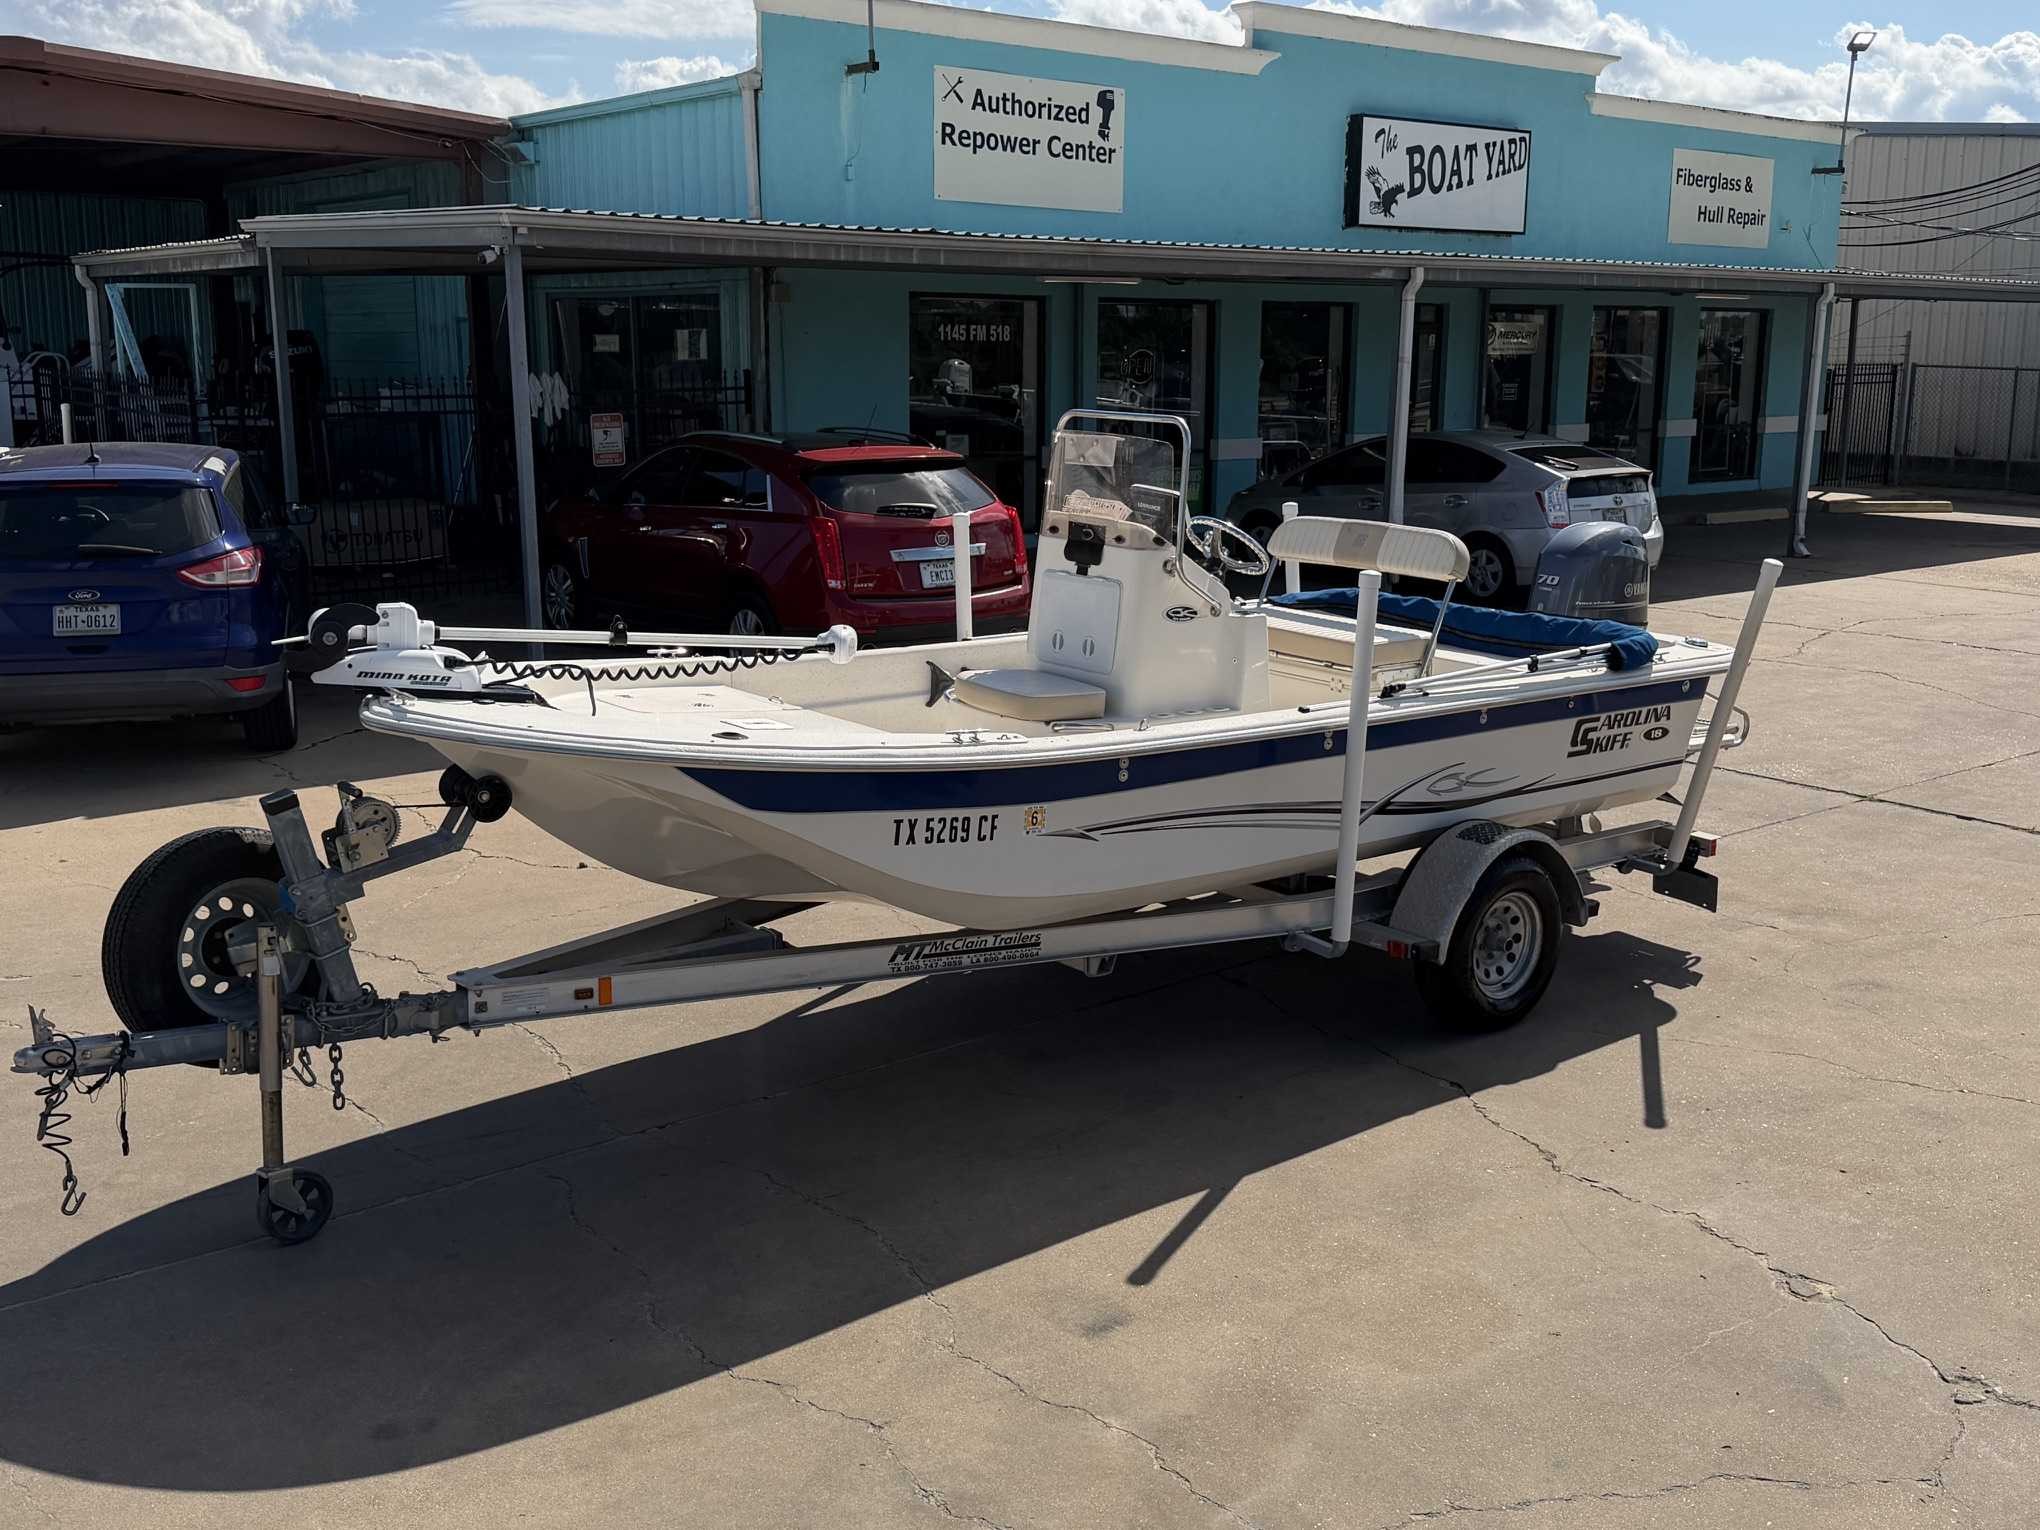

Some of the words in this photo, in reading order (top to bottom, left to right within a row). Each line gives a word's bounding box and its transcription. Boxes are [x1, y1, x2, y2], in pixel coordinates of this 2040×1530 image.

[971, 88, 1090, 125] Authorized
[940, 121, 1041, 155] Repower
[1047, 135, 1117, 164] Center
[1374, 124, 1399, 158] The
[1405, 141, 1478, 199] BOAT
[1484, 135, 1528, 181] YARD
[1676, 166, 1742, 194] Fiberglass
[1743, 176, 1754, 194] &
[1696, 206, 1725, 225] Hull
[1727, 208, 1766, 230] Repair
[938, 323, 966, 342] 1145
[969, 324, 987, 342] FM
[989, 324, 1011, 342] 518
[1497, 328, 1538, 340] MERCURY
[1537, 574, 1561, 586] 70
[1570, 705, 1672, 747] CAROLINA
[1566, 727, 1633, 759] SKIFF
[1649, 727, 1664, 739] 18
[893, 817, 919, 846] TX
[924, 816, 971, 845] 5269
[977, 813, 1000, 842] CF
[1031, 810, 1039, 827] 6
[929, 936, 988, 953] McClain
[991, 931, 1042, 947] Trailers
